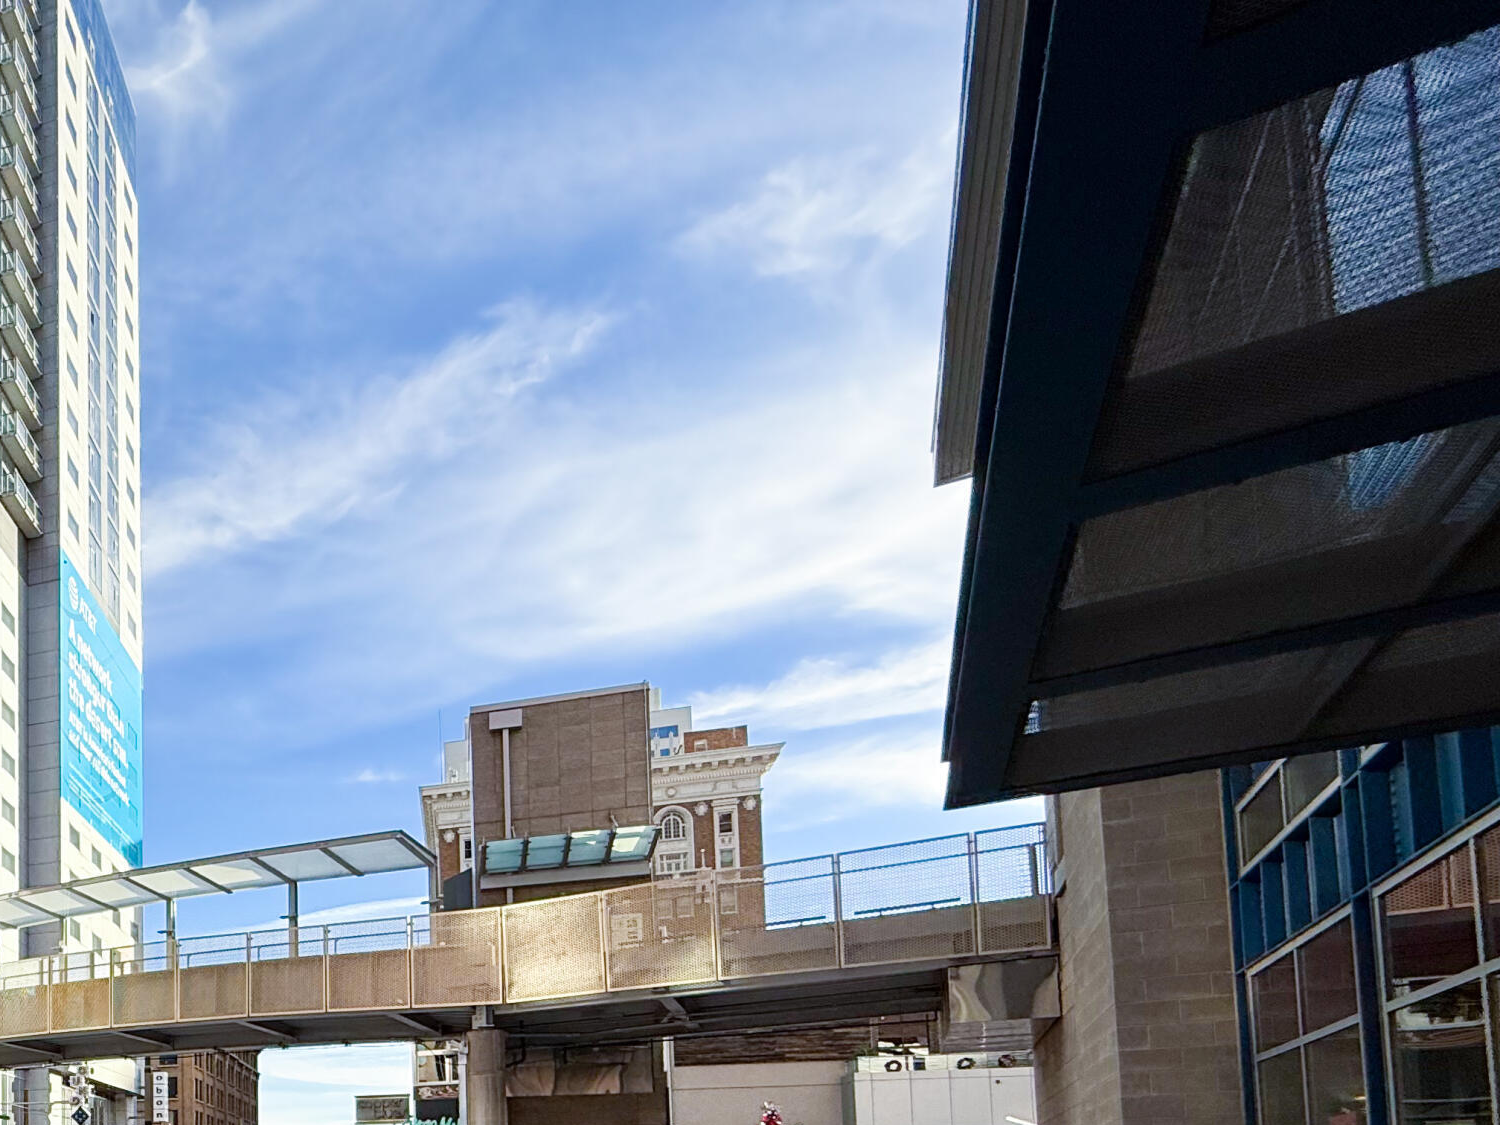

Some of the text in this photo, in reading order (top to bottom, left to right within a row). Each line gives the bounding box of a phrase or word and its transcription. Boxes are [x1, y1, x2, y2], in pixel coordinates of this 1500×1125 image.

[79, 597, 97, 635] AT&T
[68, 619, 112, 696] A network
[68, 651, 106, 713] stronger
[106, 698, 125, 739] than
[68, 676, 84, 713] the
[85, 699, 112, 748] desert
